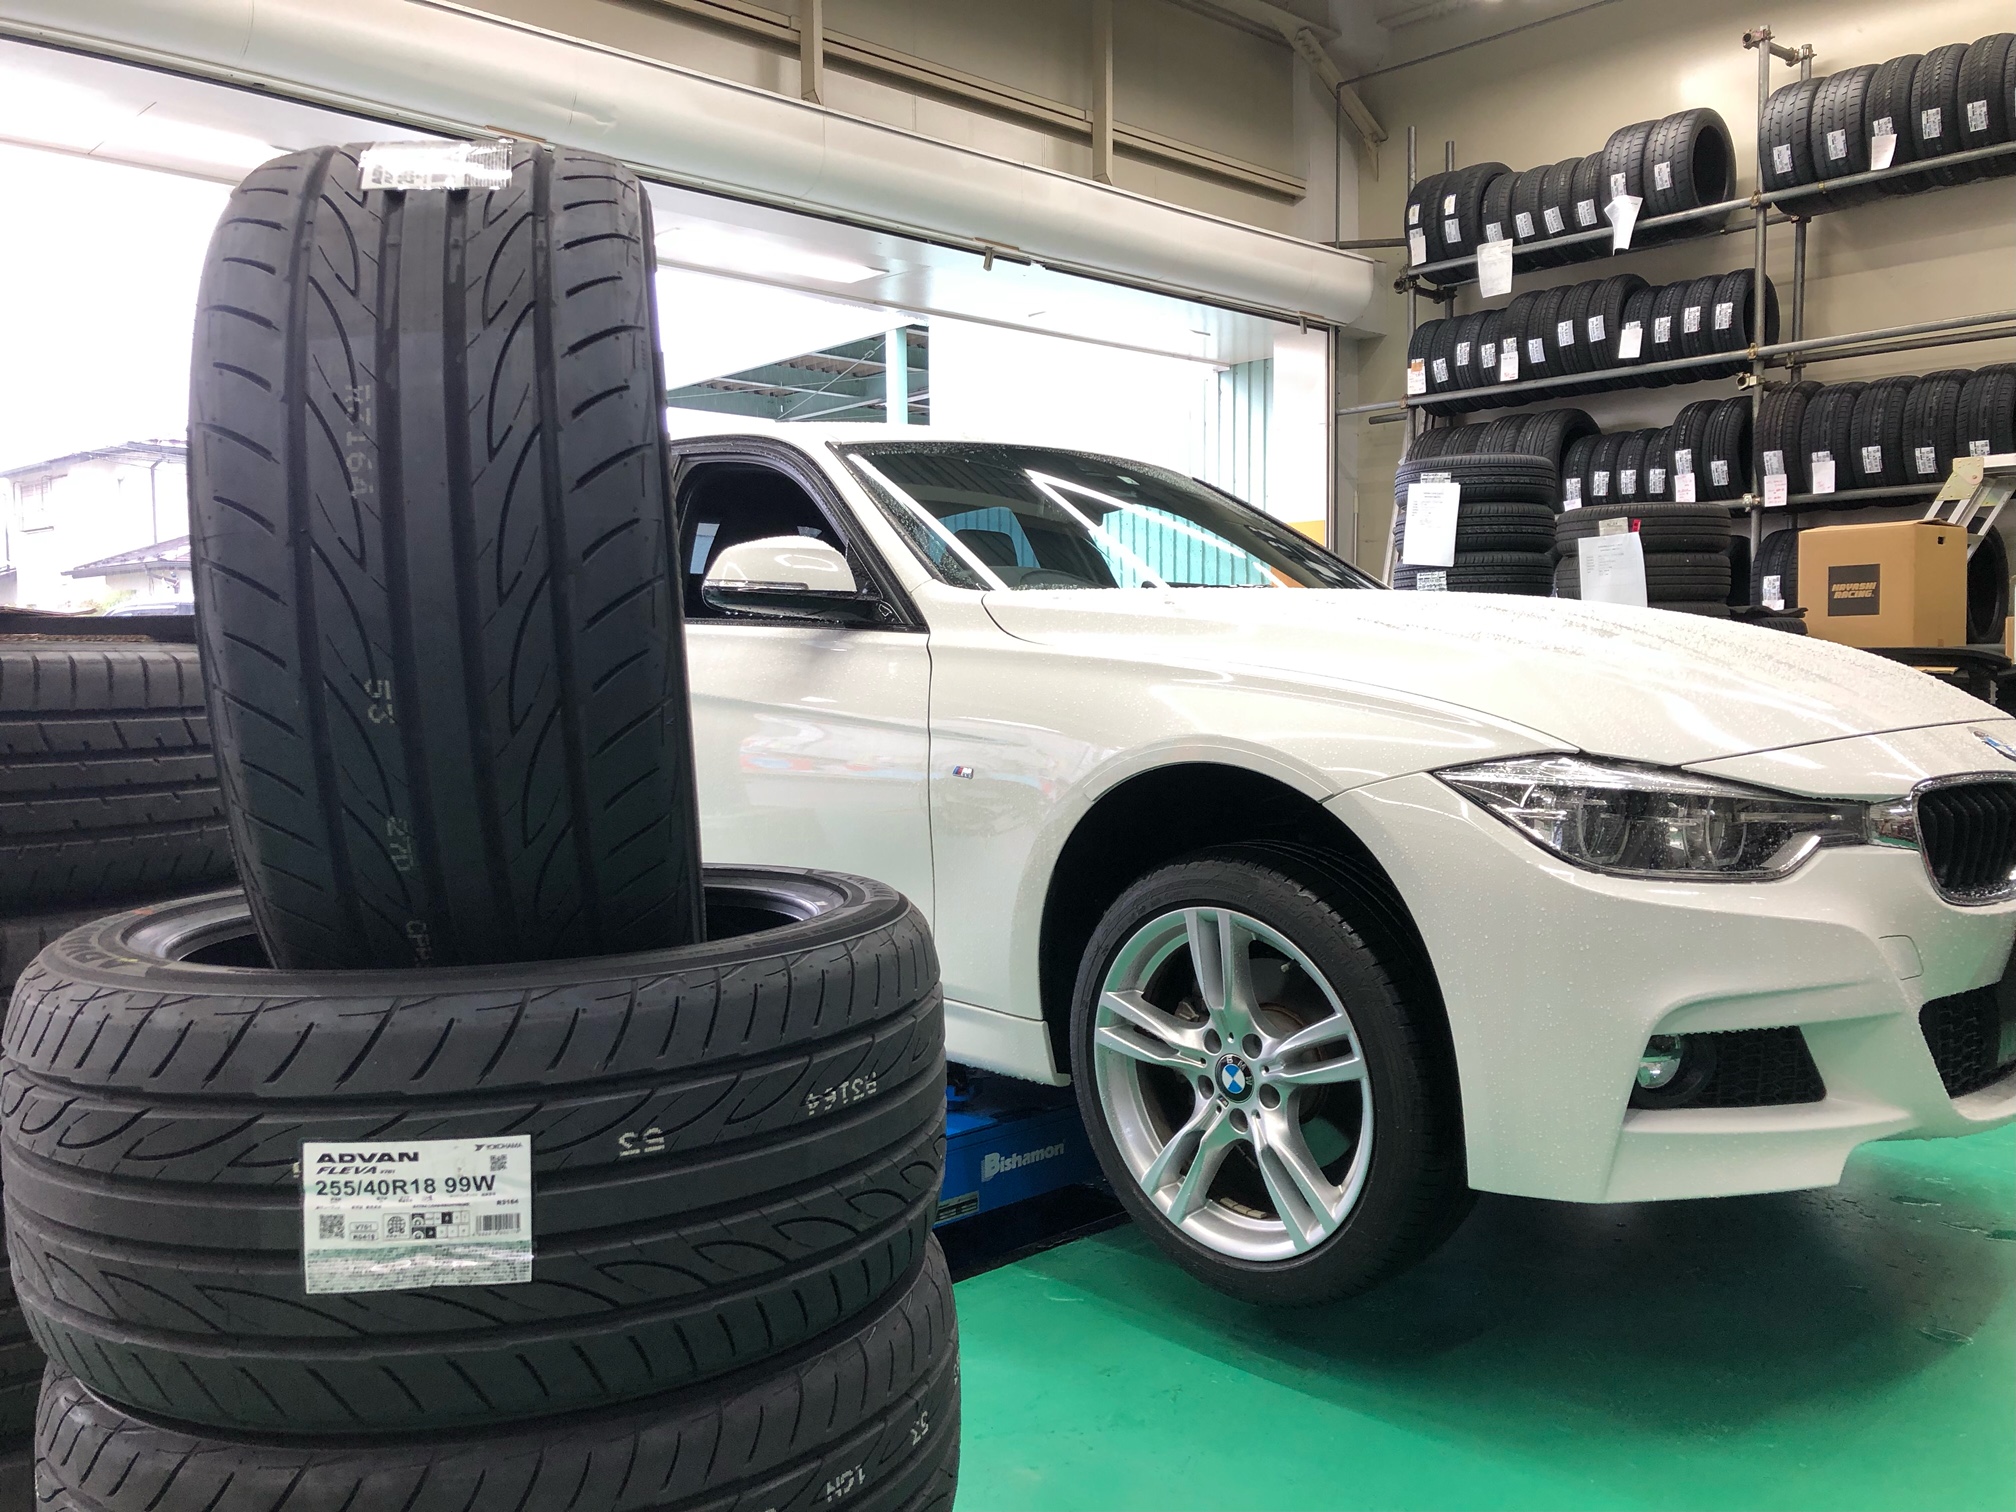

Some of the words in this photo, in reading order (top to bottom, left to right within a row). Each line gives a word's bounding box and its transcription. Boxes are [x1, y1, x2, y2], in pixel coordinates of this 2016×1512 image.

[1831, 582, 1877, 592] HAYASHI
[1833, 590, 1873, 599] RACING
[1226, 1056, 1253, 1086] BMW
[316, 1151, 420, 1164] ADVAN
[981, 1142, 1066, 1182] Bishamon
[316, 1166, 378, 1176] FLEVA
[315, 1178, 437, 1197] 255/40R18
[444, 1174, 497, 1195] 99W
